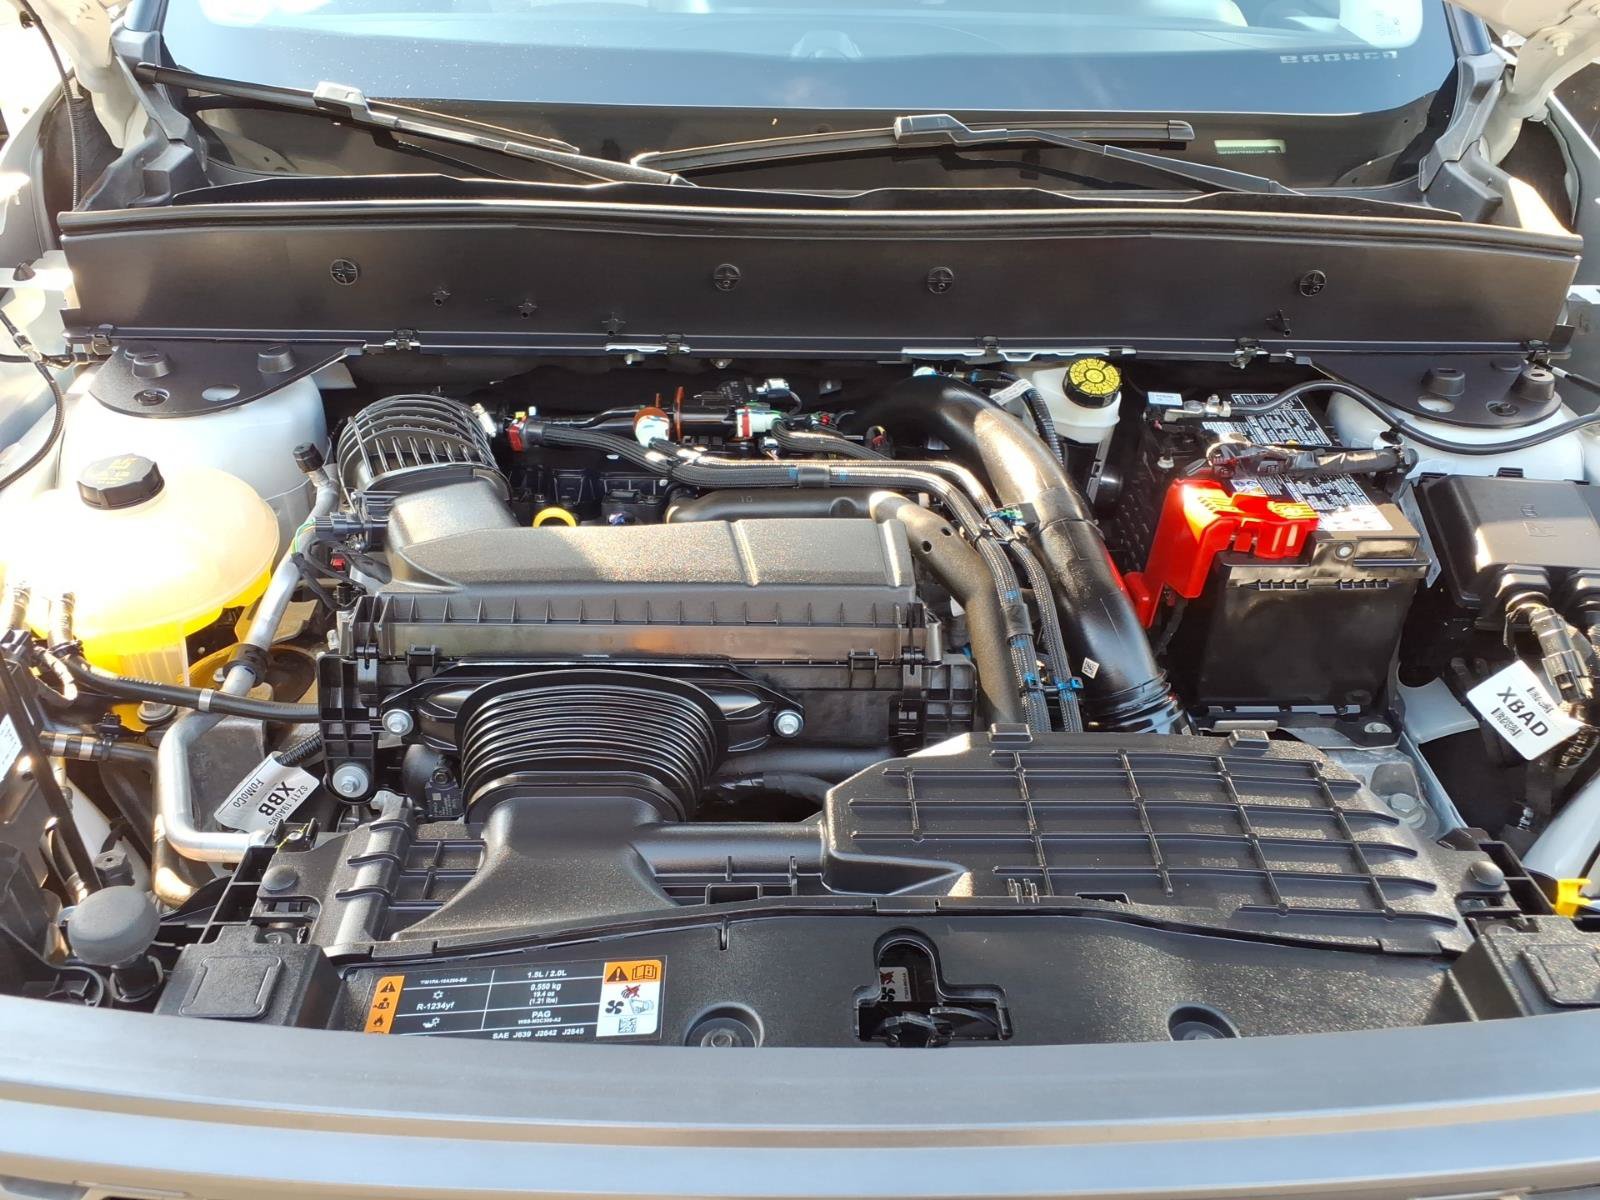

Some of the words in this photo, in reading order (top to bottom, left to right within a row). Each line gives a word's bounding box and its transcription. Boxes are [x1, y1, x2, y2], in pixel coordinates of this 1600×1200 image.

[1280, 50, 1398, 64] BRONCO
[1496, 686, 1549, 737] XBAD
[233, 778, 265, 808] FoMoCo
[258, 781, 296, 817] XBB
[550, 969, 568, 978] 2.0L
[530, 982, 551, 992] 0.550
[551, 982, 562, 991] kg
[416, 1001, 455, 1011] R-1234yf
[531, 1010, 552, 1019] PAG
[492, 1031, 510, 1040] SAE
